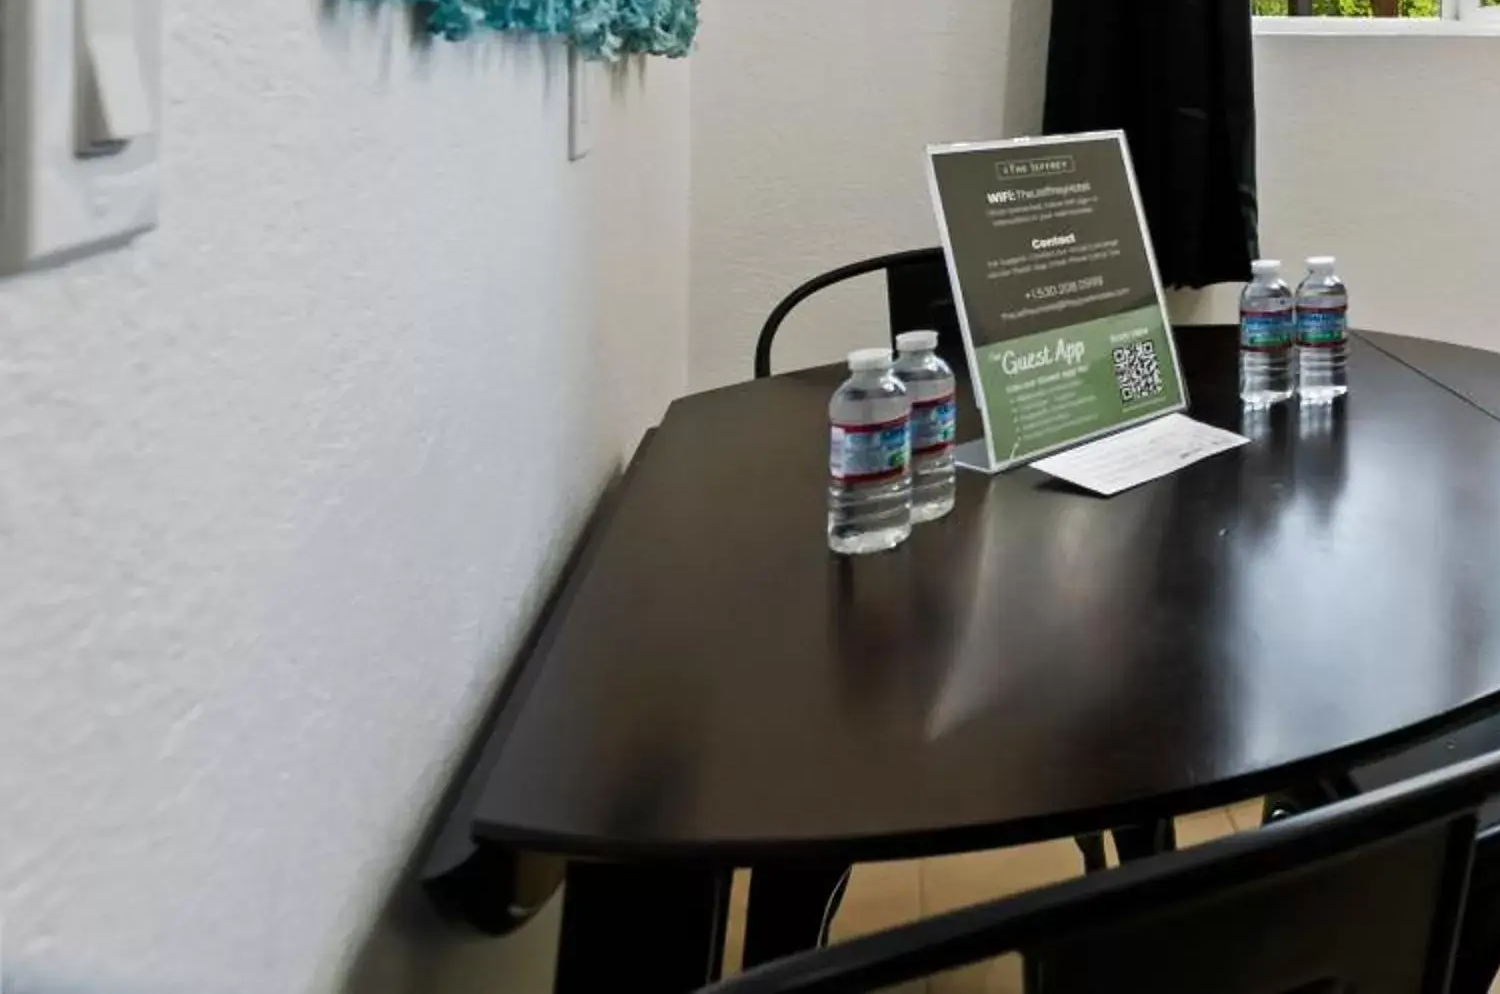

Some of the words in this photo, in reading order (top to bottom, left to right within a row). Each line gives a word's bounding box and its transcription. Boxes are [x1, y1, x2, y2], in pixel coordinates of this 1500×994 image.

[1031, 232, 1076, 249] Contact
[1001, 346, 1051, 376] Guest
[1052, 337, 1085, 366] App
